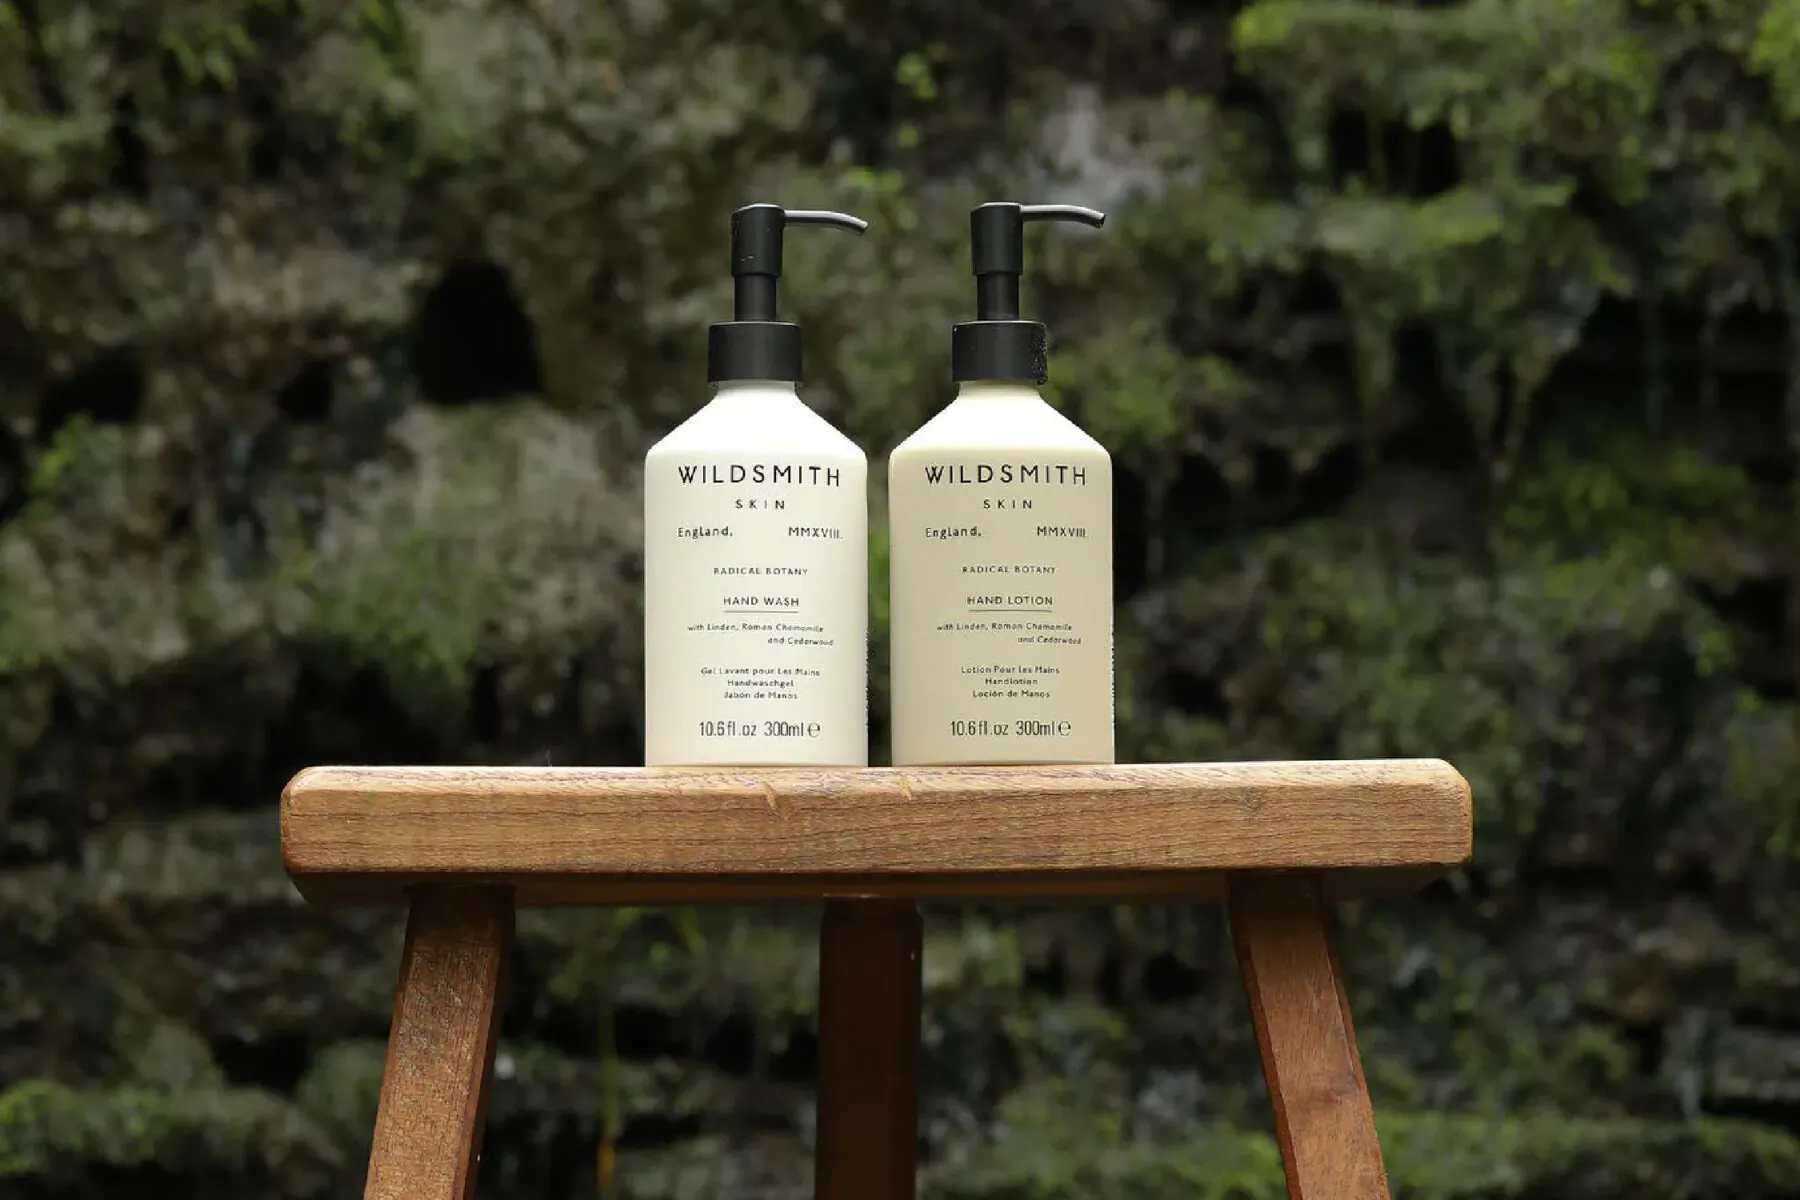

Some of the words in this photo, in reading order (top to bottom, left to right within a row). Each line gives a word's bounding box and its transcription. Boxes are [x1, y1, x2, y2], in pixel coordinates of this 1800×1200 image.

[677, 463, 840, 488] WILDSMITH
[924, 463, 1086, 486] WILDSMITH
[734, 498, 785, 511] SKIN
[983, 498, 1033, 510] SKIN
[713, 566, 761, 576] RADICAL
[765, 567, 808, 576] BOTANY
[962, 565, 1010, 575] RADICAL
[1014, 565, 1057, 574] BOTANY
[723, 596, 759, 607] HAND
[763, 597, 800, 607] WASH
[966, 595, 1003, 606] HAND
[1007, 596, 1053, 606] LOTION
[687, 623, 705, 633] with
[741, 622, 773, 632] Roman
[775, 623, 824, 634] Chamomile
[936, 622, 954, 632] with
[956, 622, 989, 632] Linden,
[991, 622, 1023, 631] Roman
[1025, 622, 1073, 632] Chamomile
[767, 636, 786, 646] and
[787, 636, 835, 647] Cedarwood
[1017, 635, 1035, 645] and
[1036, 635, 1082, 645] Cedarwood
[700, 666, 717, 676] Gel
[719, 666, 750, 676] Lavant
[752, 668, 775, 677] pour
[794, 667, 822, 678] Mains
[960, 664, 992, 674] Lotion
[1034, 665, 1061, 674] Mains
[727, 679, 794, 690] Handwaschgel
[984, 677, 1039, 686] Handlotion
[723, 690, 751, 700] Jabón
[753, 691, 766, 700] de
[767, 691, 799, 700] Manos
[972, 688, 1004, 699] Loción
[1006, 689, 1019, 699] de
[1020, 689, 1051, 699] Manos
